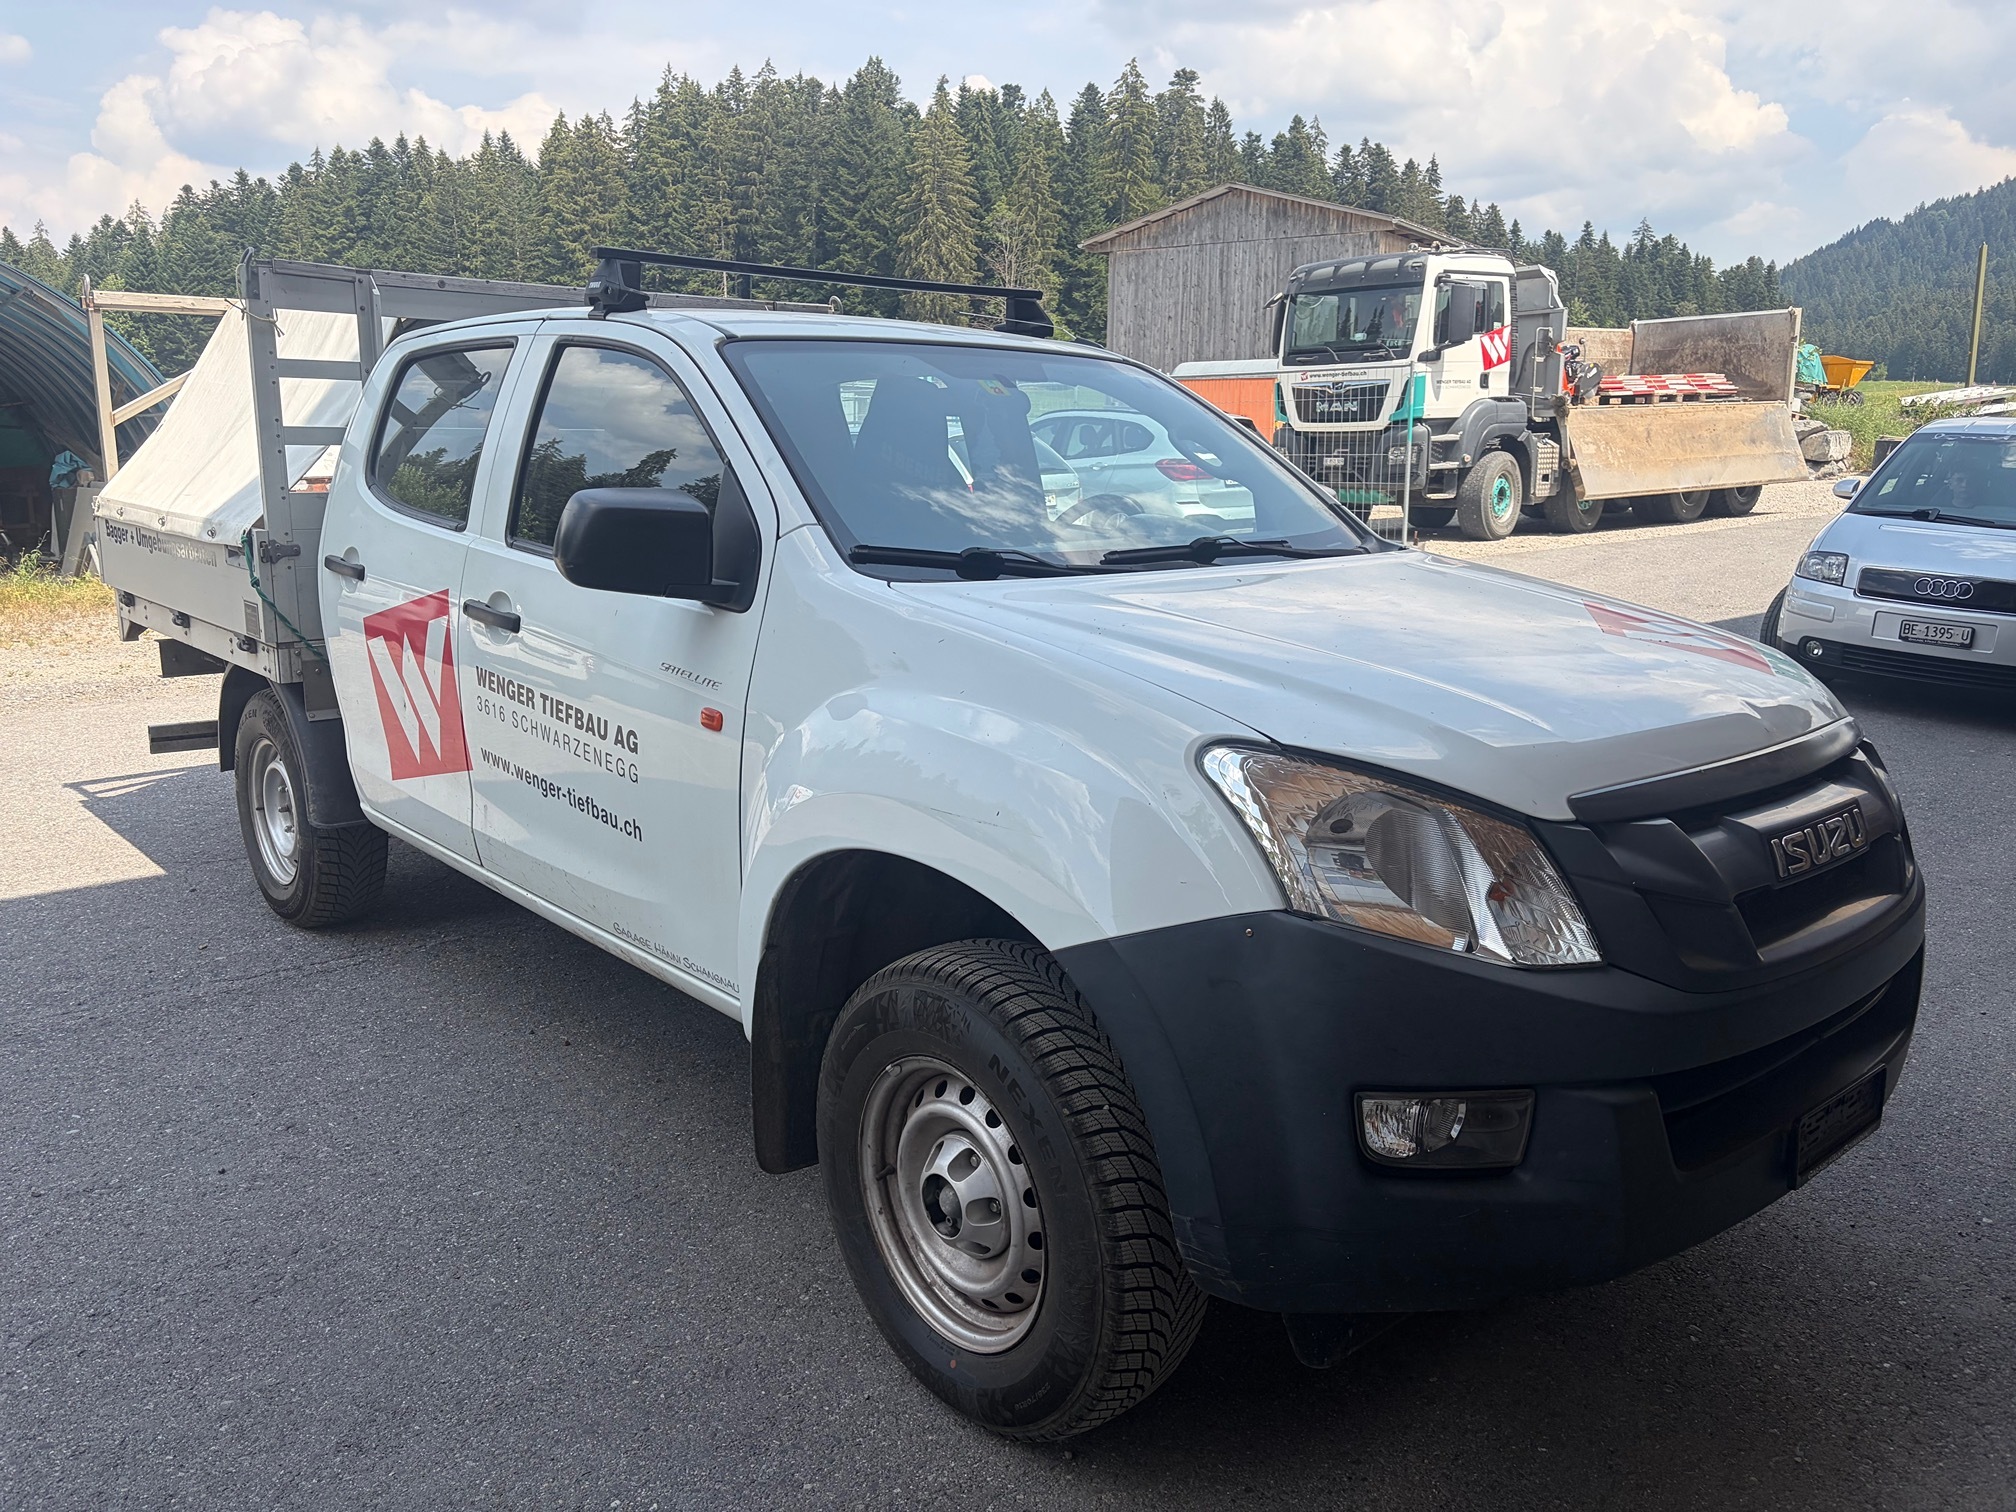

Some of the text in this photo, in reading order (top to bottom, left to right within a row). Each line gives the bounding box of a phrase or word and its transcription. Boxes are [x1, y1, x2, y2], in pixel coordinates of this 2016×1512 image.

[1316, 401, 1358, 412] MAN
[104, 518, 128, 545] Bagger
[475, 665, 639, 755] WENGER TIEFBAU AG
[659, 662, 723, 691] SATELLITE
[476, 695, 639, 784] 3616 SCHWARZENEGG
[480, 747, 643, 842] www.wenger-tiefbau.ch
[1770, 808, 1867, 878] ISUZU
[612, 921, 653, 951] GARAGE
[987, 1053, 1069, 1198] NEXEN
